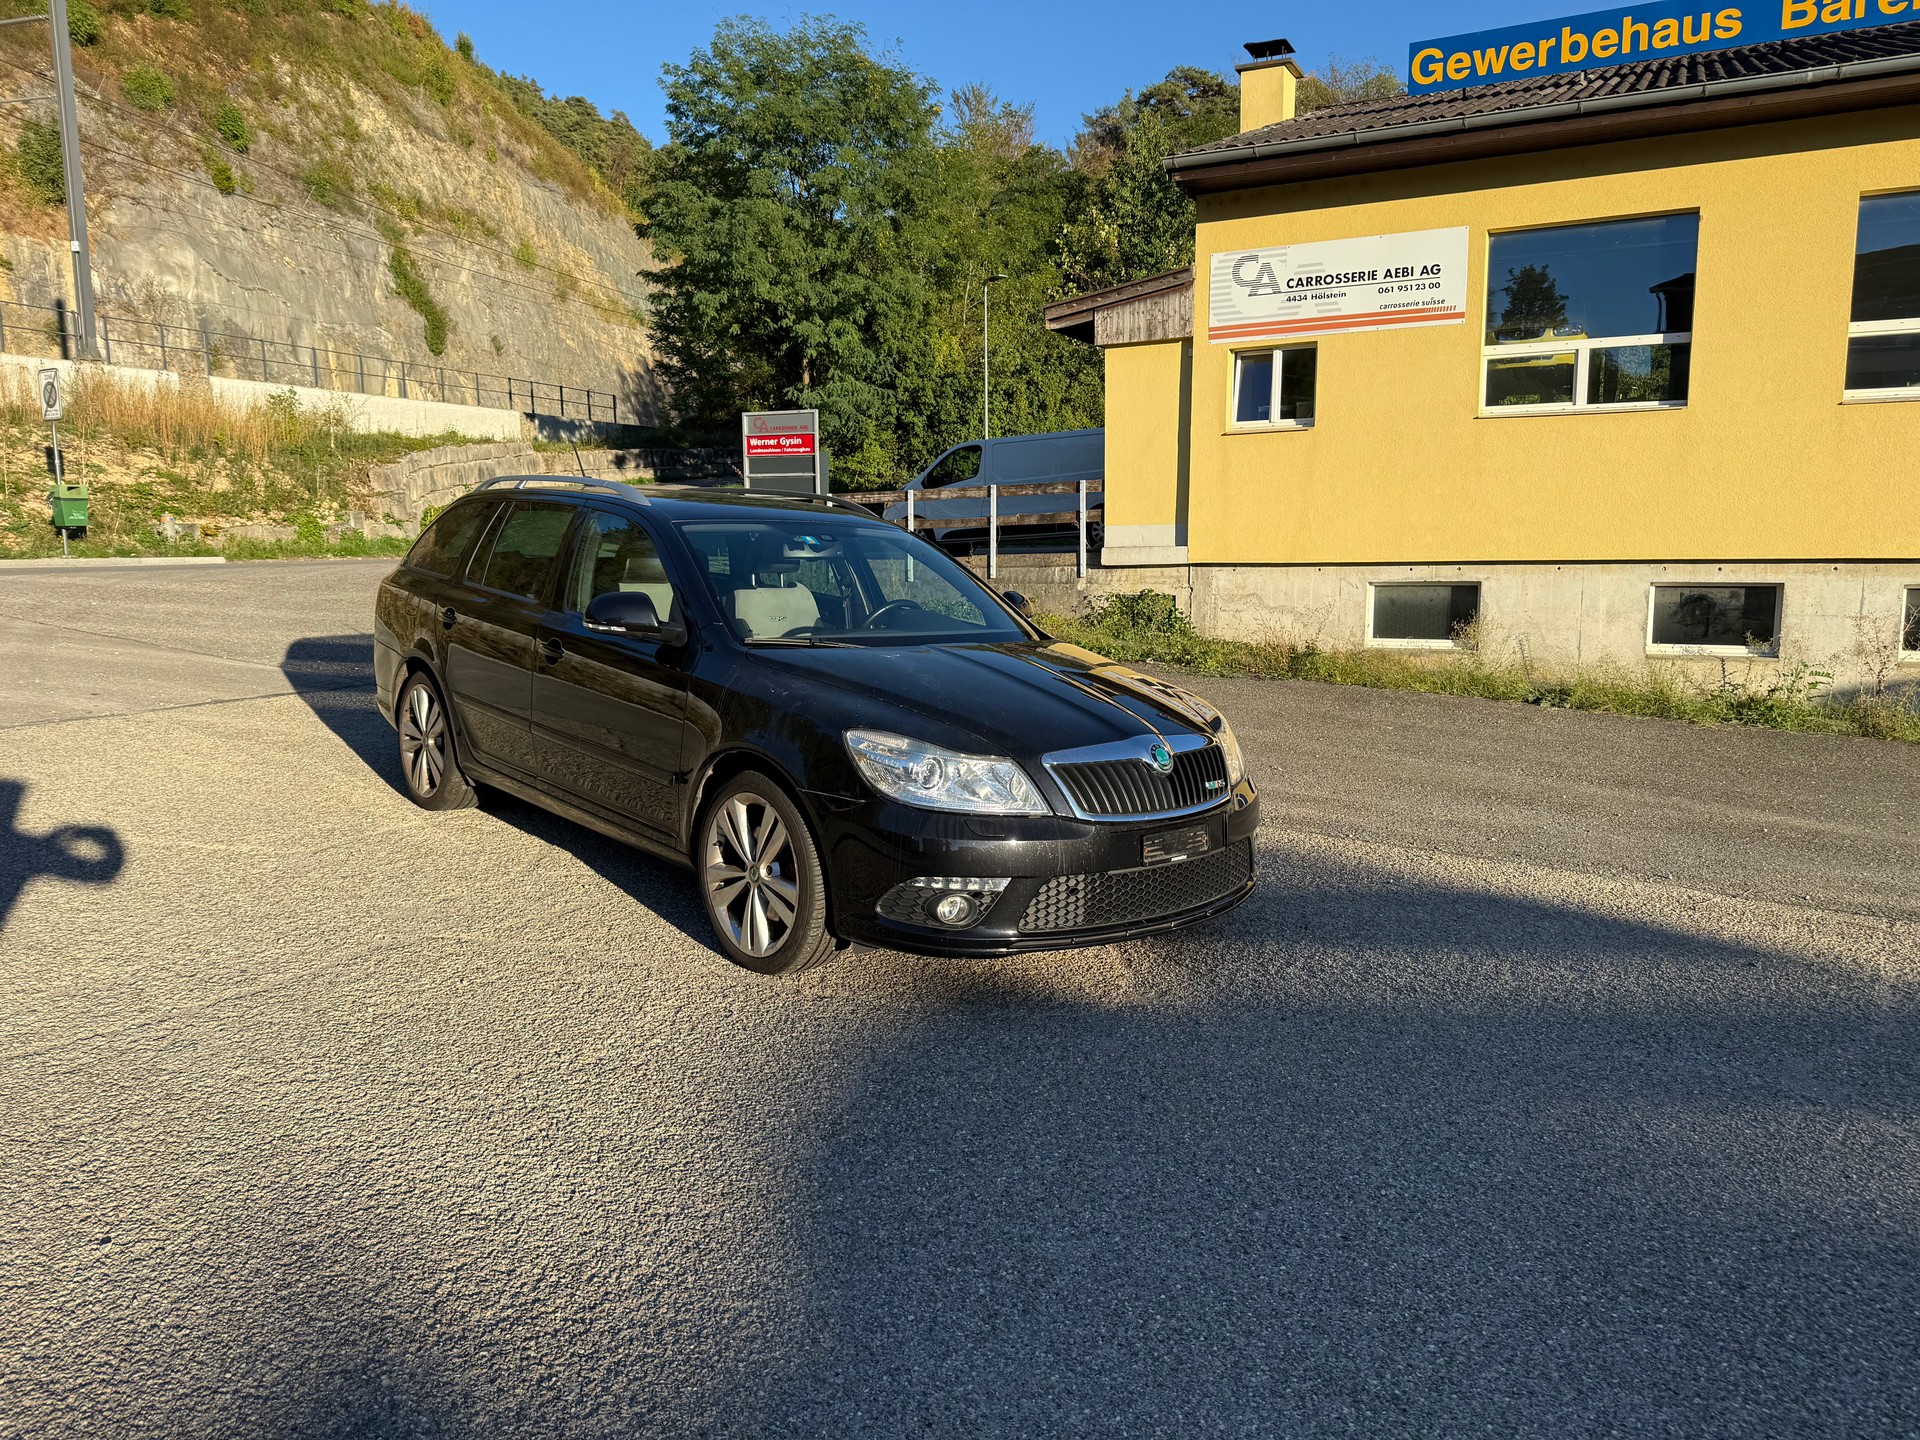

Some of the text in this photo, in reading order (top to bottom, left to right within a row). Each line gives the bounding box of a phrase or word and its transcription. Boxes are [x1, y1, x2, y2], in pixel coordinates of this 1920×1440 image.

[1411, 7, 1743, 85] Gewerbehaus
[1286, 263, 1441, 289] CARROSSERIE AEBI AG
[1378, 286, 1394, 295] 061
[1428, 281, 1441, 290] 00
[1286, 290, 1346, 303] 4434 Hölstein
[1379, 297, 1446, 310] carrosserie suisse
[750, 436, 802, 447] Werner Gysin
